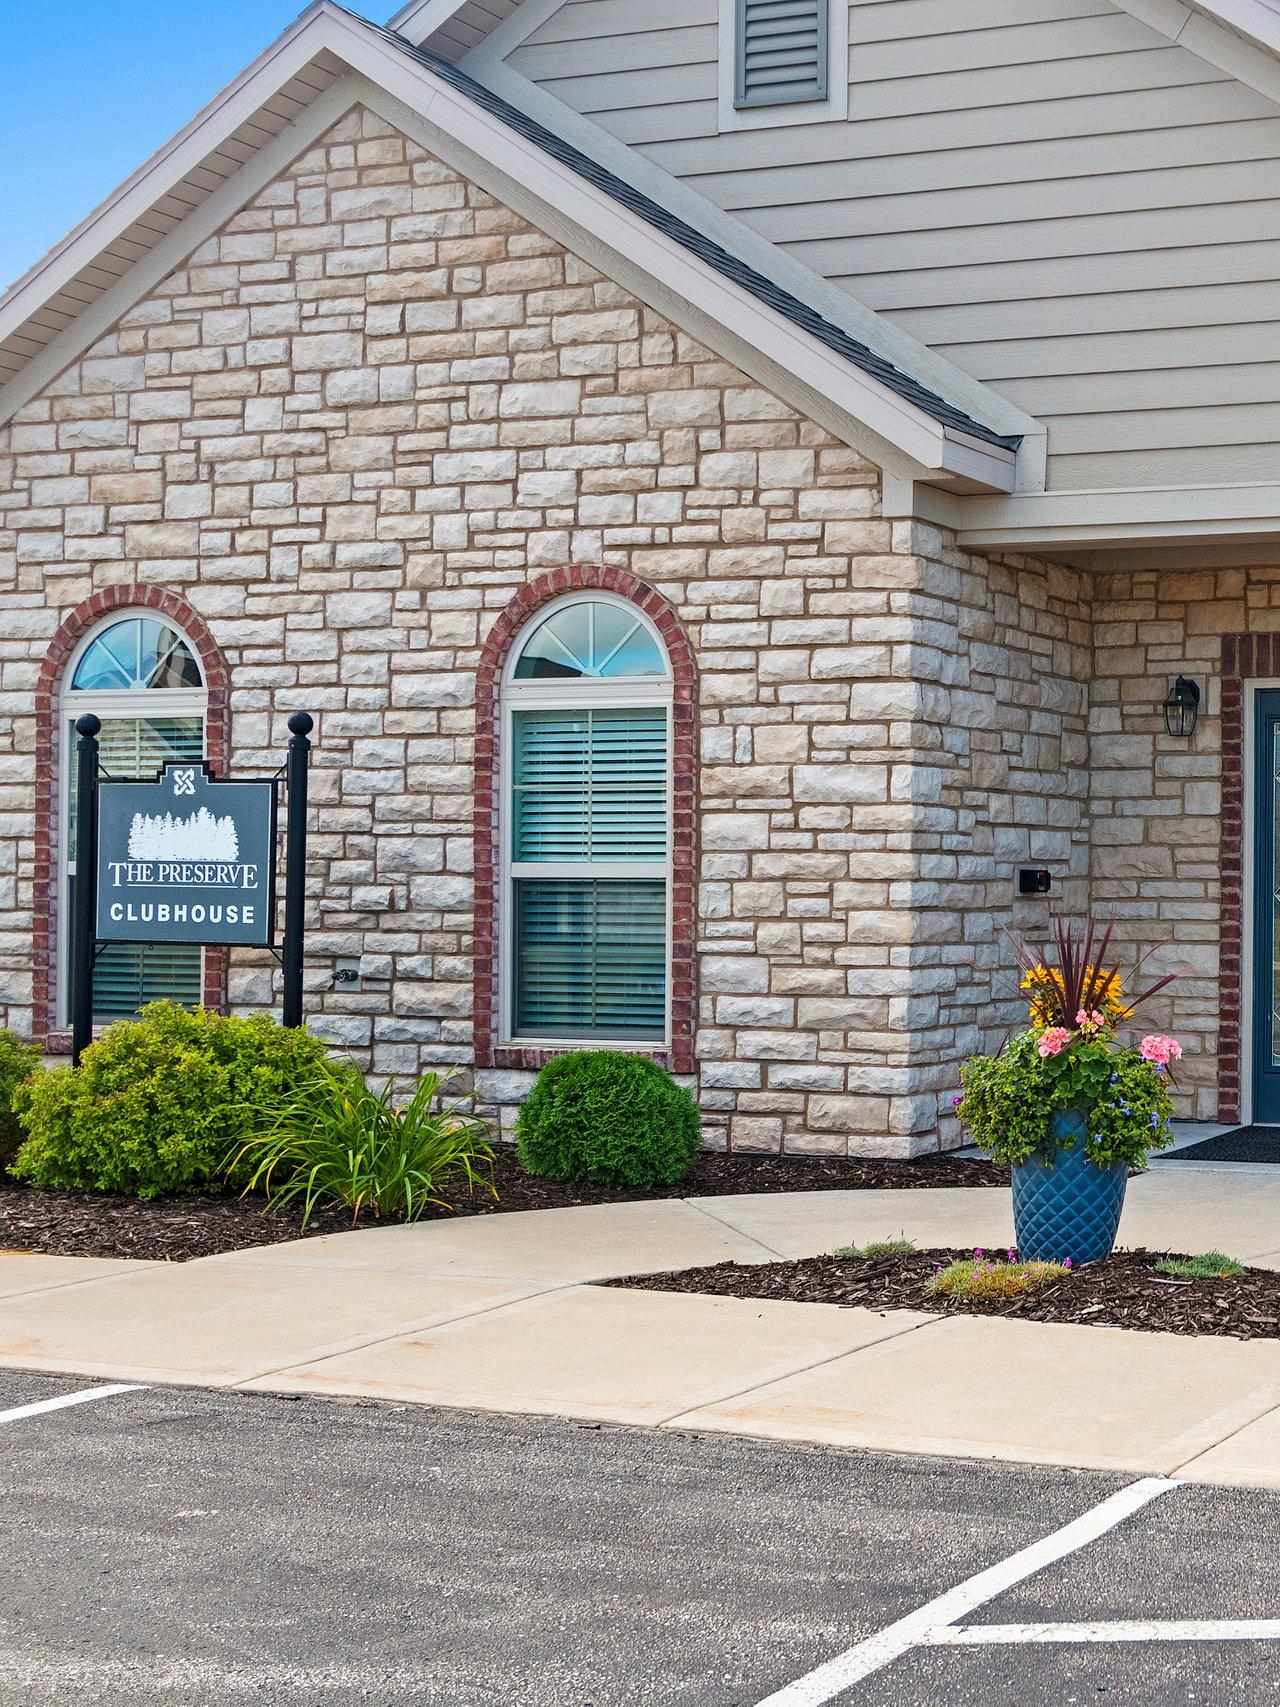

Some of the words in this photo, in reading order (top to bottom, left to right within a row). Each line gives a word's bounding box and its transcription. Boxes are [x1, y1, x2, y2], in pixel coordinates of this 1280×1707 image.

[108, 862, 154, 887] THE
[159, 864, 258, 889] PRESERVE
[110, 903, 255, 924] CLUBHOUSE
